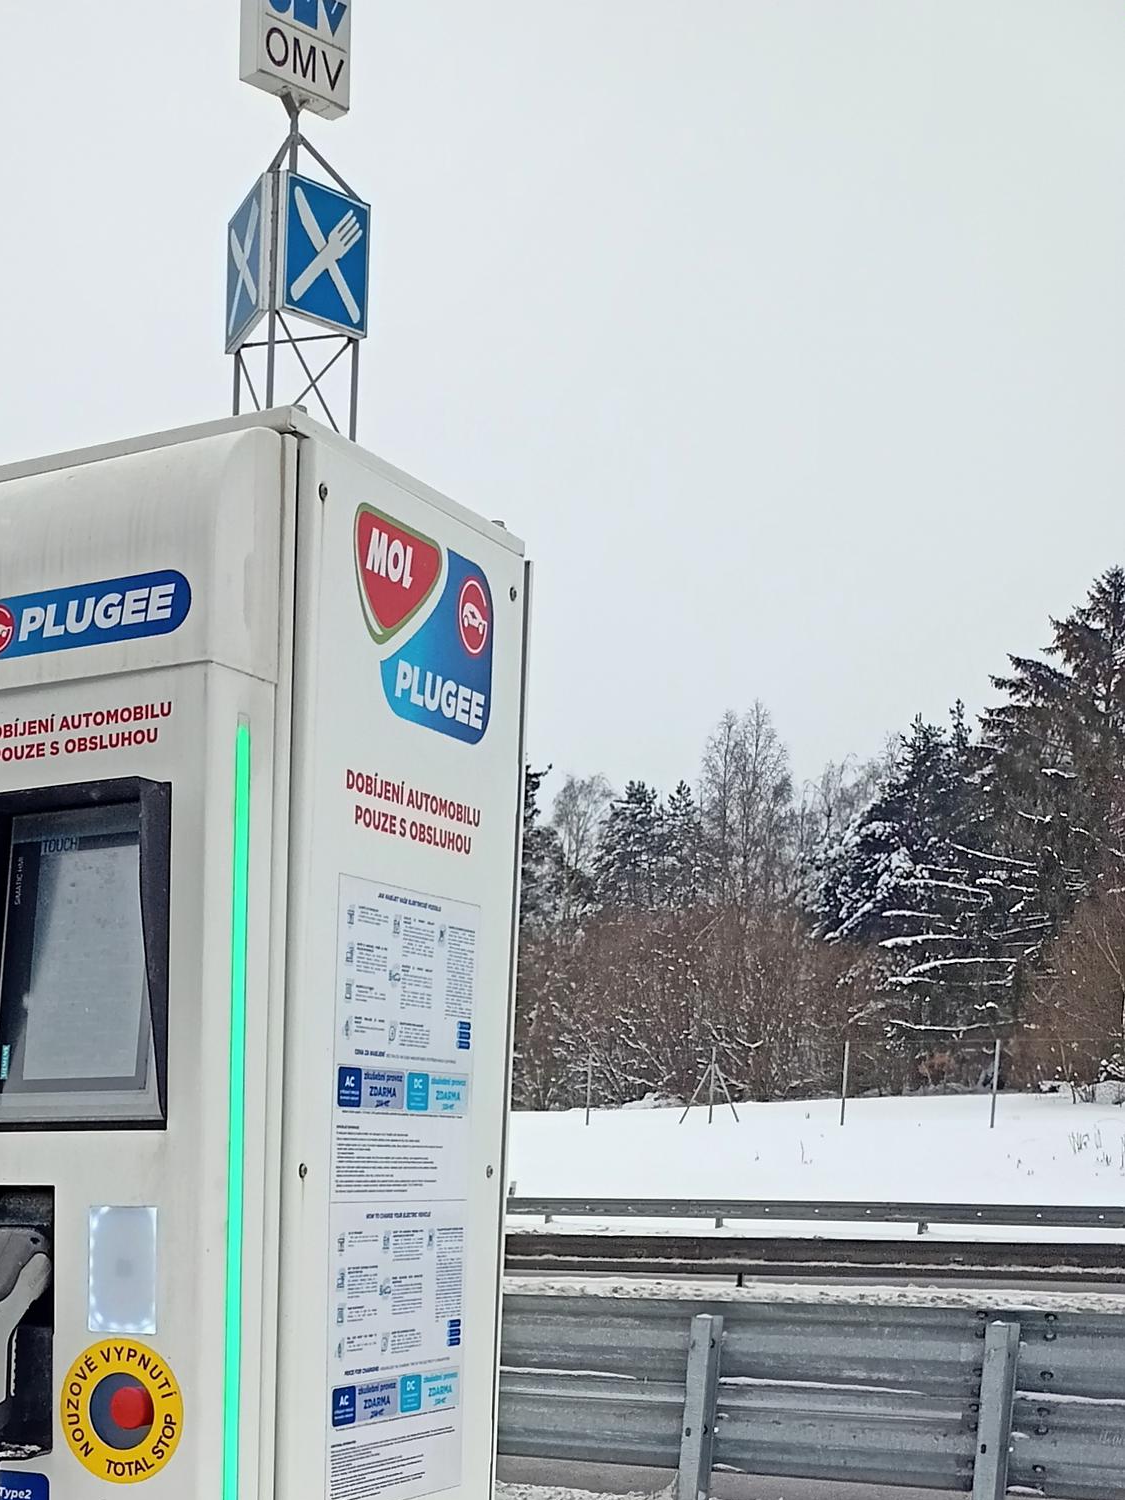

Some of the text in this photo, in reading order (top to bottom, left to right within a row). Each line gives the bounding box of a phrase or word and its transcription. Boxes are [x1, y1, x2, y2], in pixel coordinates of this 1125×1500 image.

[266, 27, 345, 91] OMV
[365, 526, 414, 590] MOL
[18, 583, 176, 643] PLUGEE
[394, 658, 485, 731] PLUGEE
[59, 700, 173, 731] AUTOMOBILU
[50, 739, 60, 756] S
[64, 727, 160, 755] OBSLUHOU
[346, 767, 481, 828] DOBÍJENÍ AUTOMOBILU
[354, 804, 472, 856] POUZE S OBSLUHOU
[42, 837, 78, 854] TOUCH
[344, 1075, 356, 1088] AC
[369, 1086, 397, 1098] ZDARMA
[413, 1078, 423, 1089] DC
[406, 1380, 416, 1391] DC
[66, 1345, 178, 1458] NOUZOVÉ VYPNUTÍ
[339, 1395, 350, 1407] AC
[363, 1395, 391, 1410] ZDARMA
[105, 1413, 178, 1477] TOTAL STOP
[0, 1486, 33, 1500] Type2
